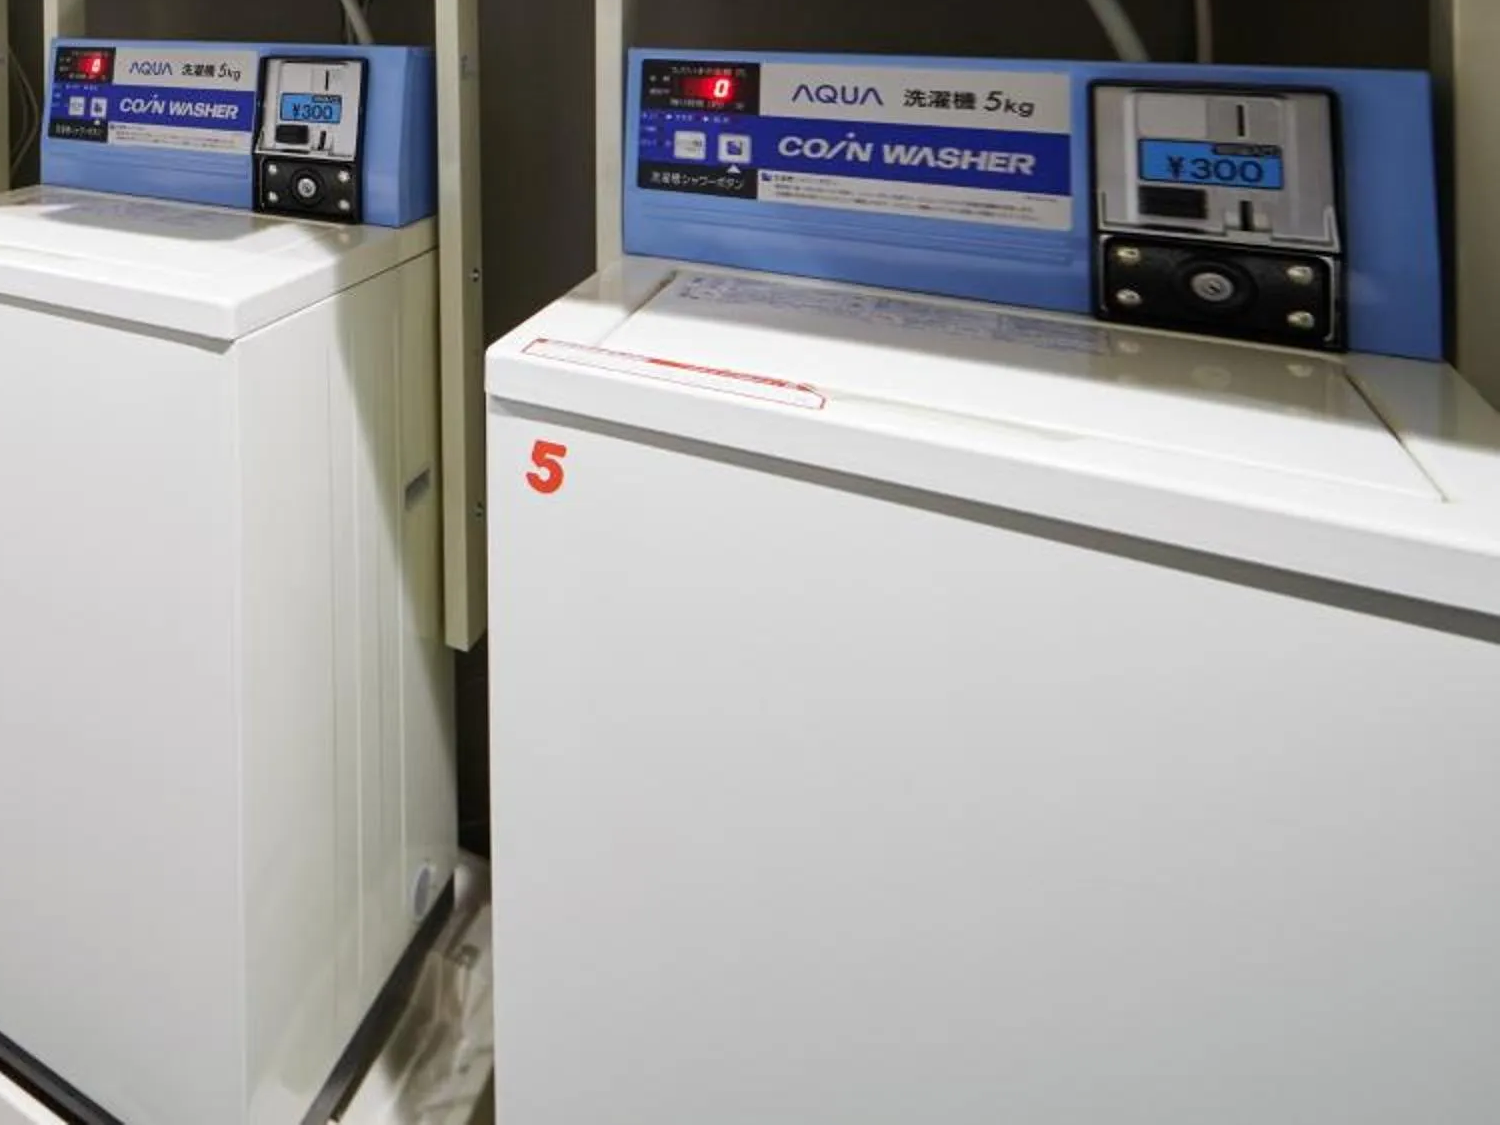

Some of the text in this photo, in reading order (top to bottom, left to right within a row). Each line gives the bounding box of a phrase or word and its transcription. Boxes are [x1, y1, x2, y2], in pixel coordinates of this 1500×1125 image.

[129, 62, 173, 77] AQUA
[713, 79, 730, 98] 0
[792, 84, 1036, 118] AQUA 洗濯機 5kg
[119, 94, 239, 121] COIN WASHER
[292, 103, 334, 121] ¥300
[778, 132, 1037, 175] COIN WASHER
[1166, 154, 1264, 184] ¥300
[526, 440, 567, 493] 5
